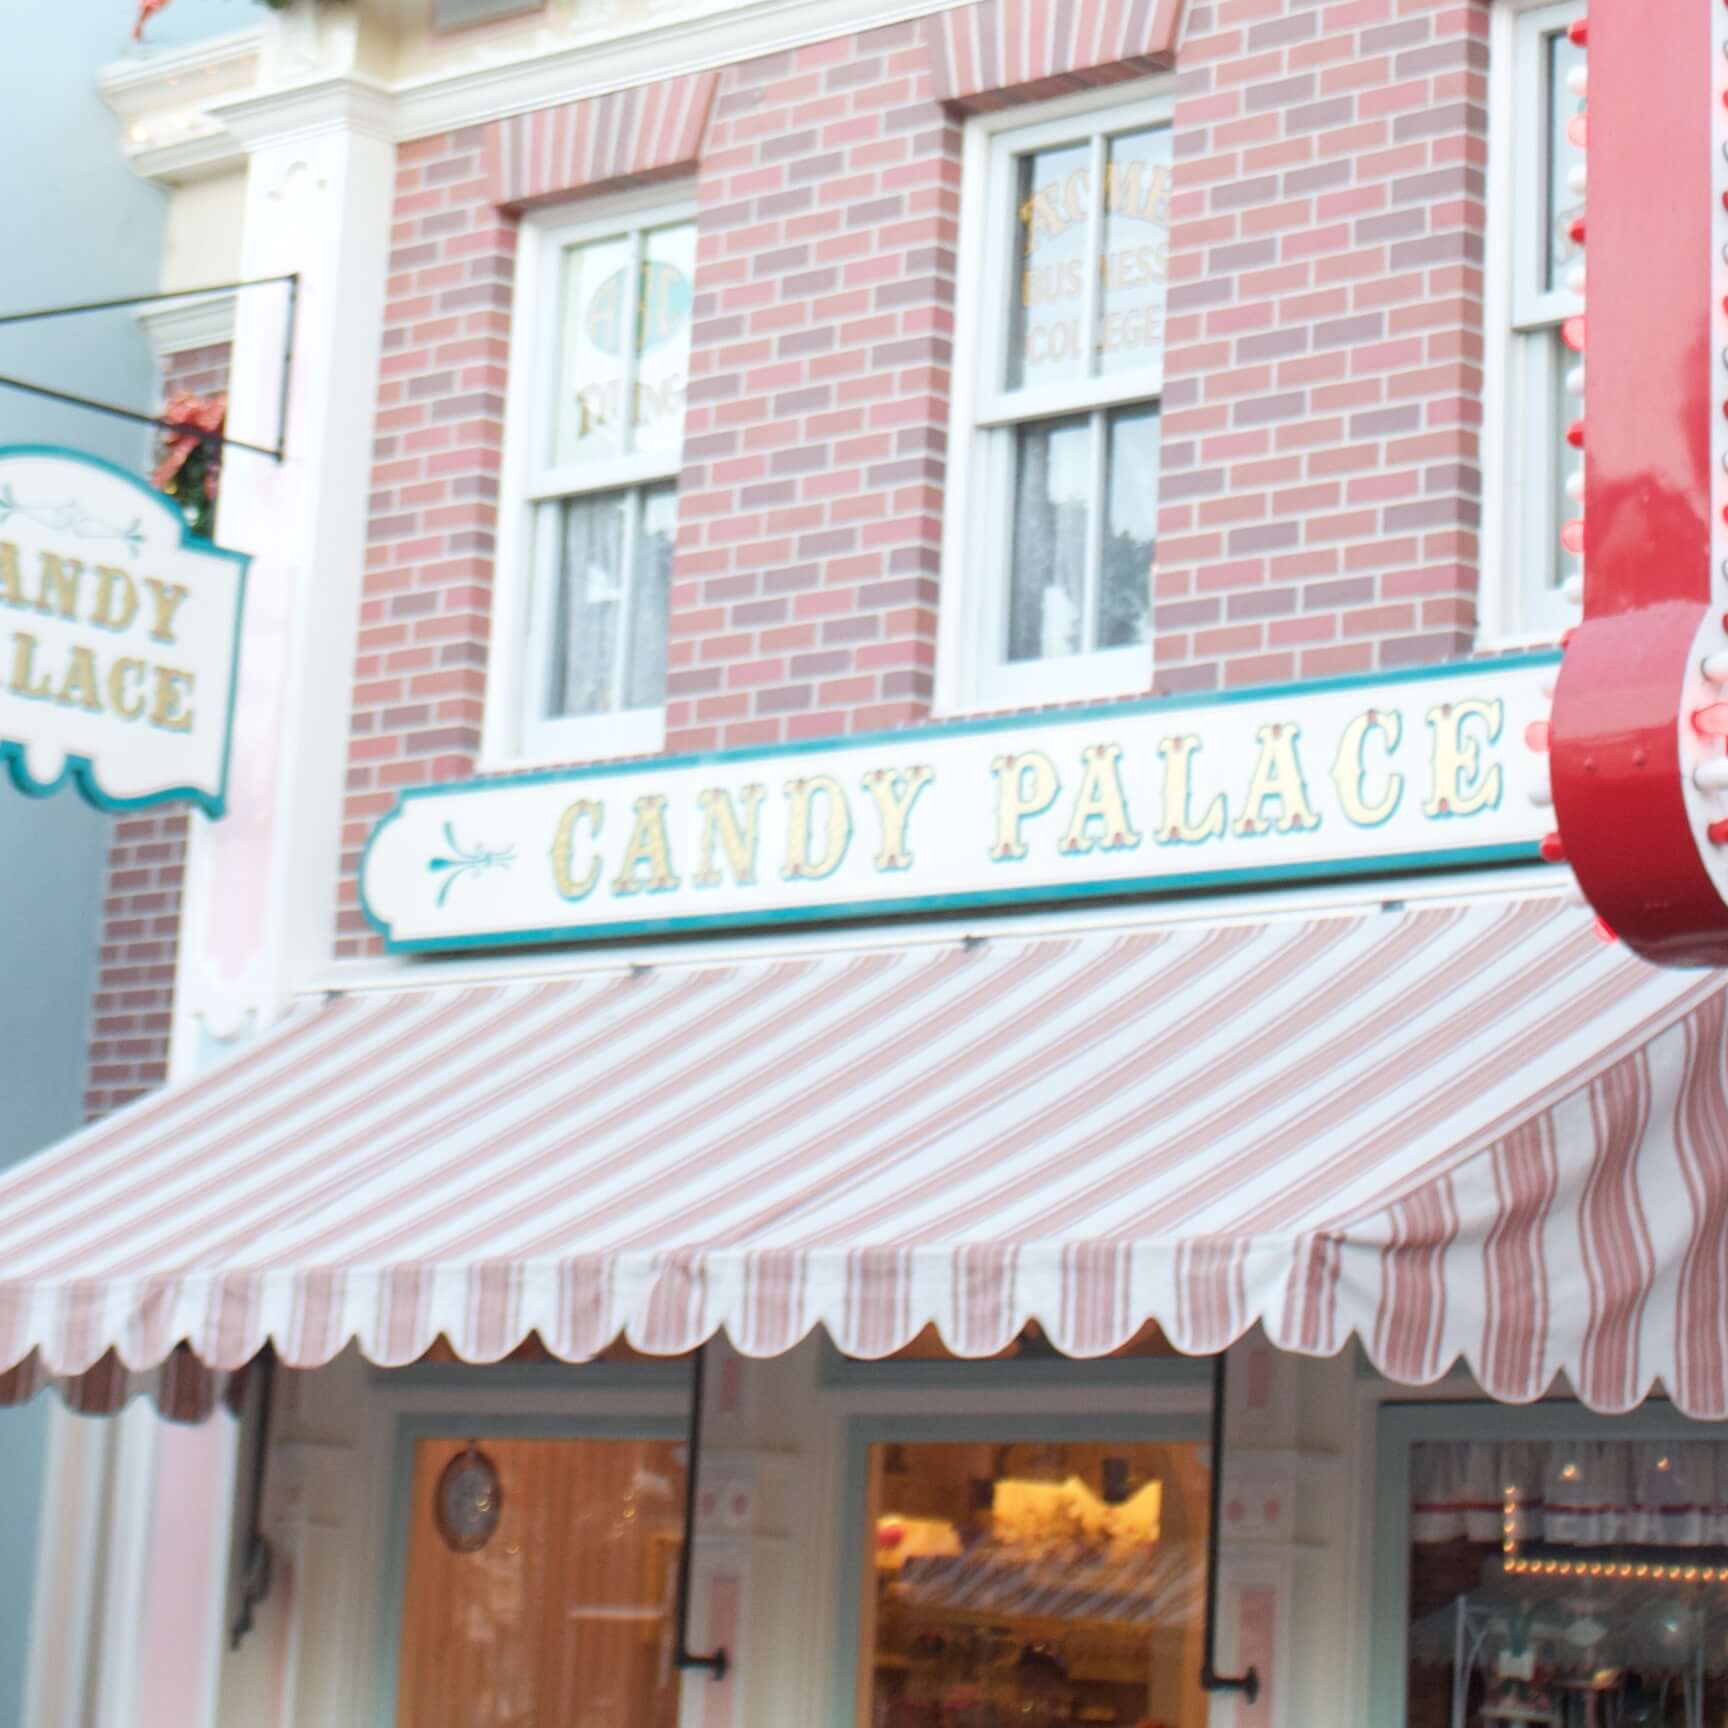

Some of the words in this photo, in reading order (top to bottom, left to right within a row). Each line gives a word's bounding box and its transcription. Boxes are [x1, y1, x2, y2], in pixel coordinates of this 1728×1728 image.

[1022, 242, 1168, 308] BUSNESS
[1027, 304, 1161, 367] COLEGE
[547, 765, 935, 901] CANDY
[988, 698, 1508, 862] PALACE
